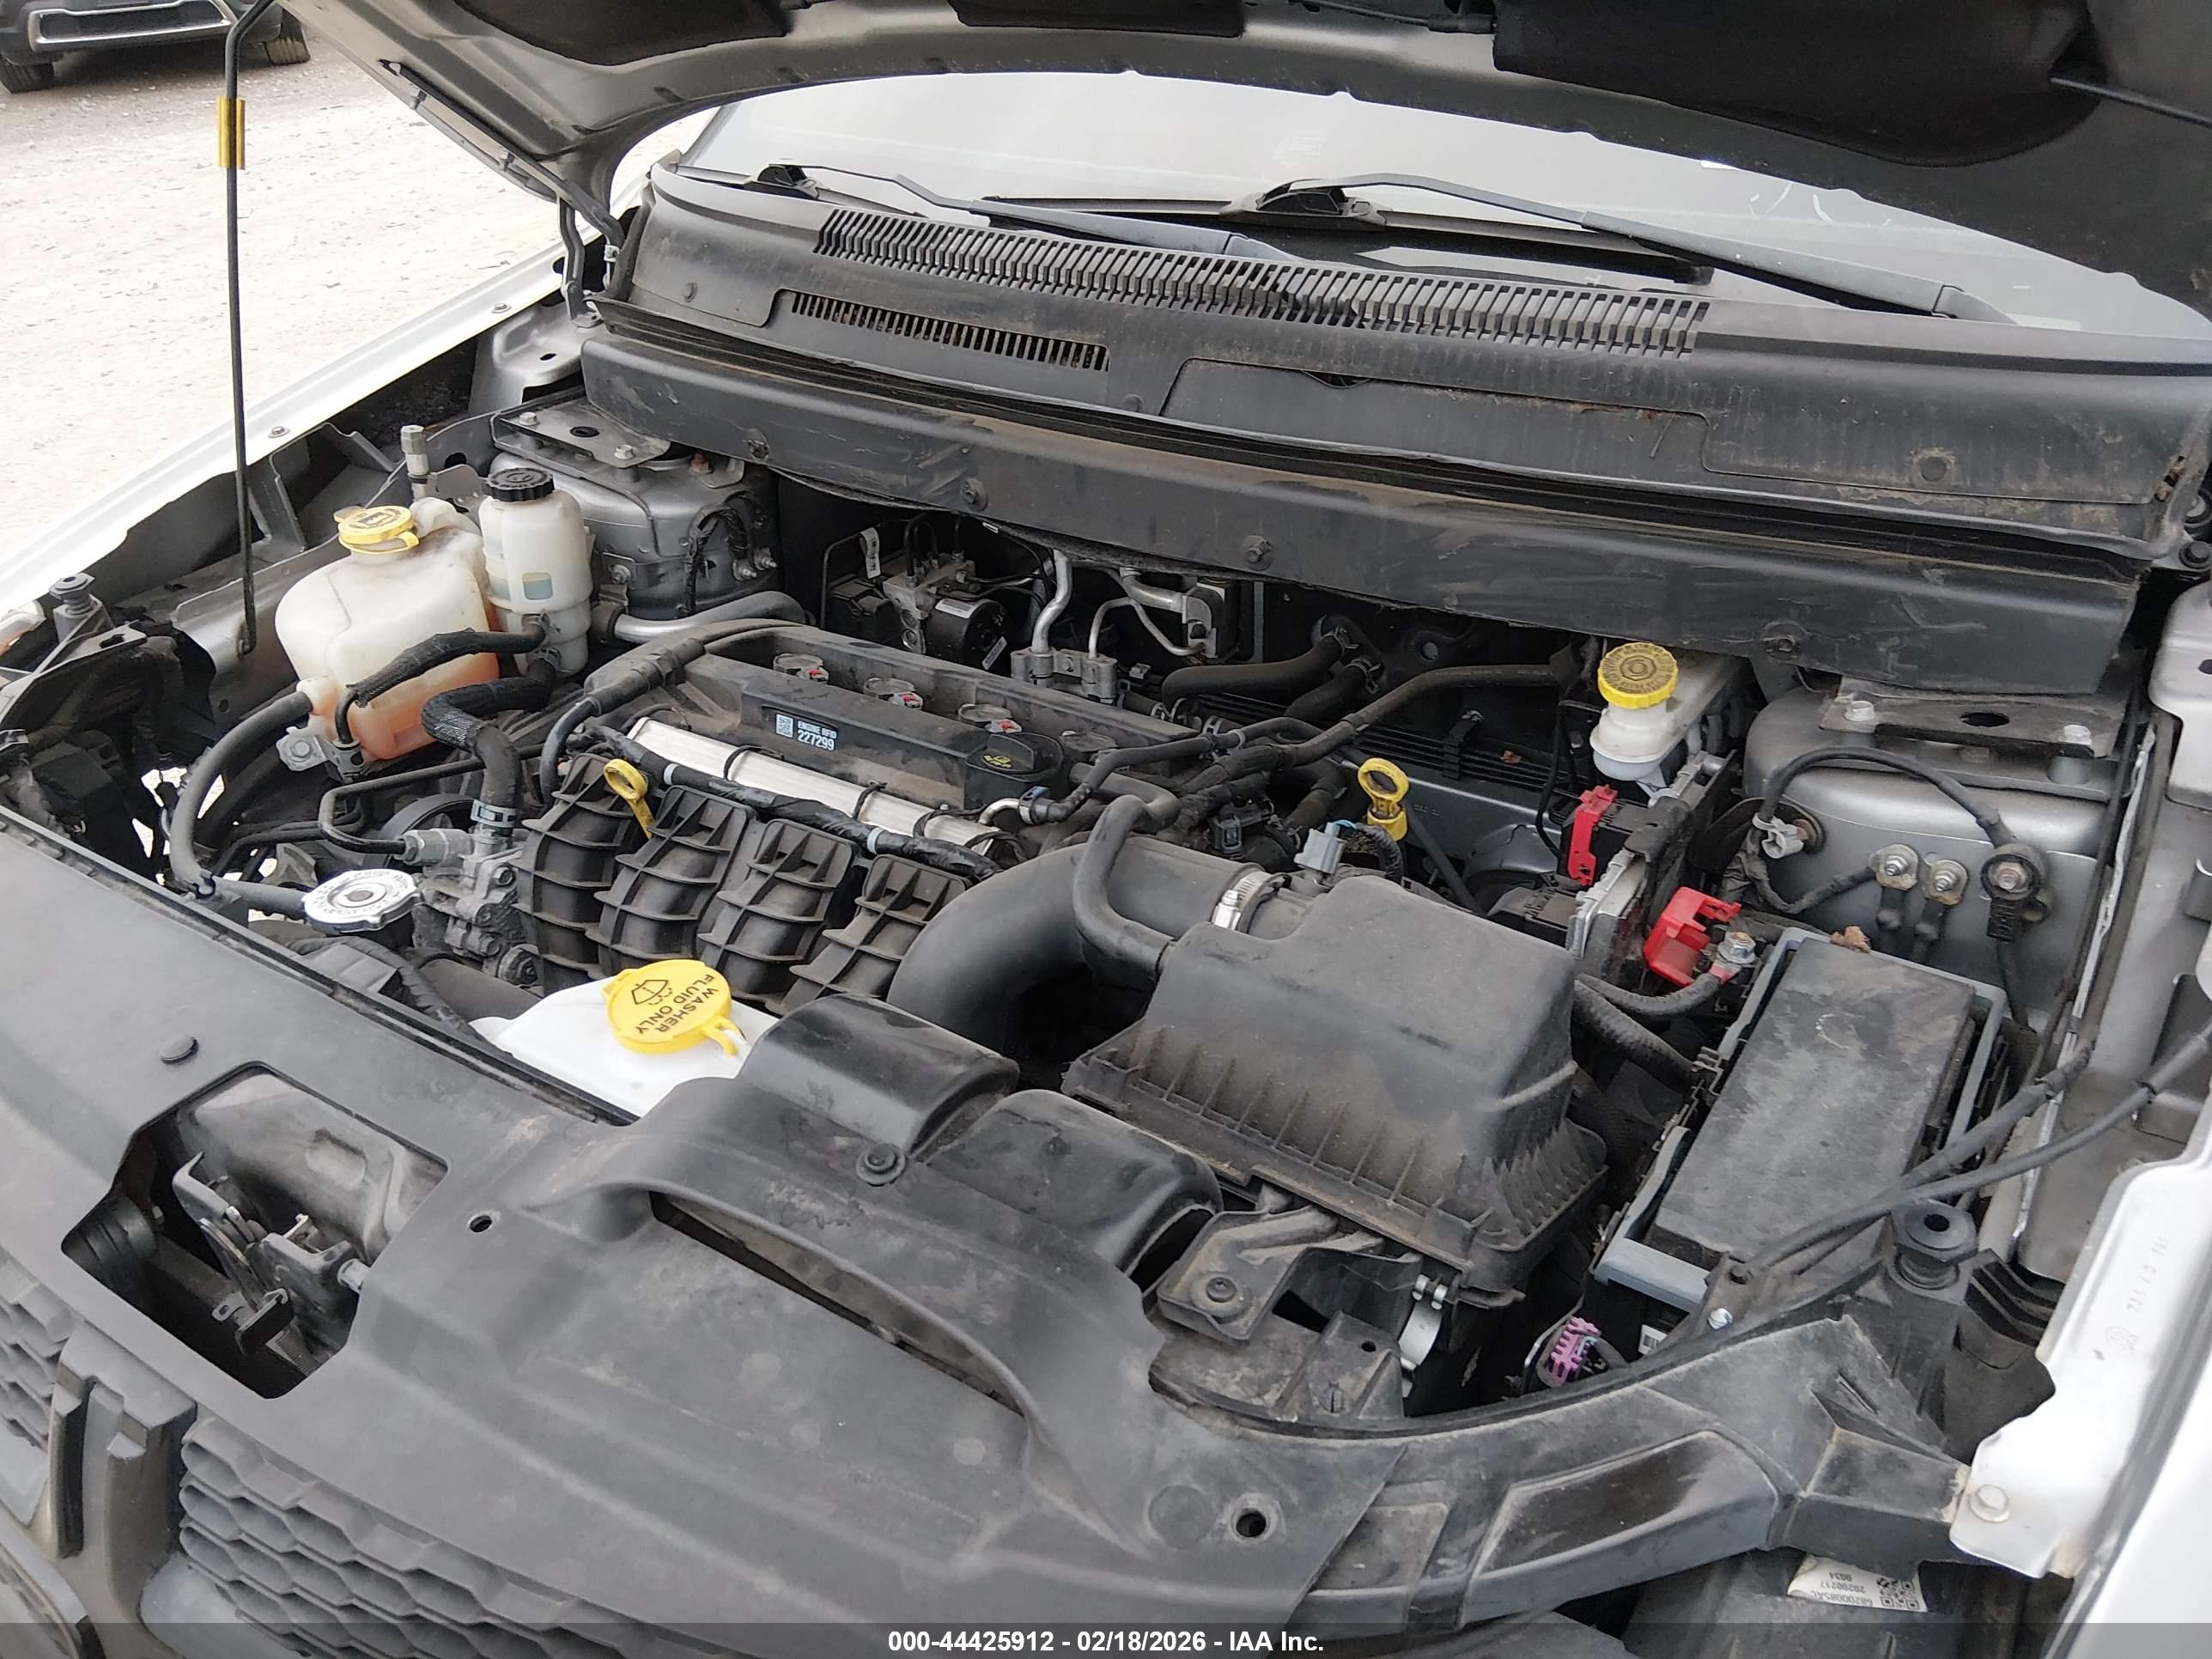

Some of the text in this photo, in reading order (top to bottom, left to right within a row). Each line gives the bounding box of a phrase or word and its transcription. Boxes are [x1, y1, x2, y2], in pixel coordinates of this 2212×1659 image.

[797, 729, 835, 750] 227299
[635, 974, 714, 1034] FLUID ONLY
[654, 988, 719, 1033] WASHER
